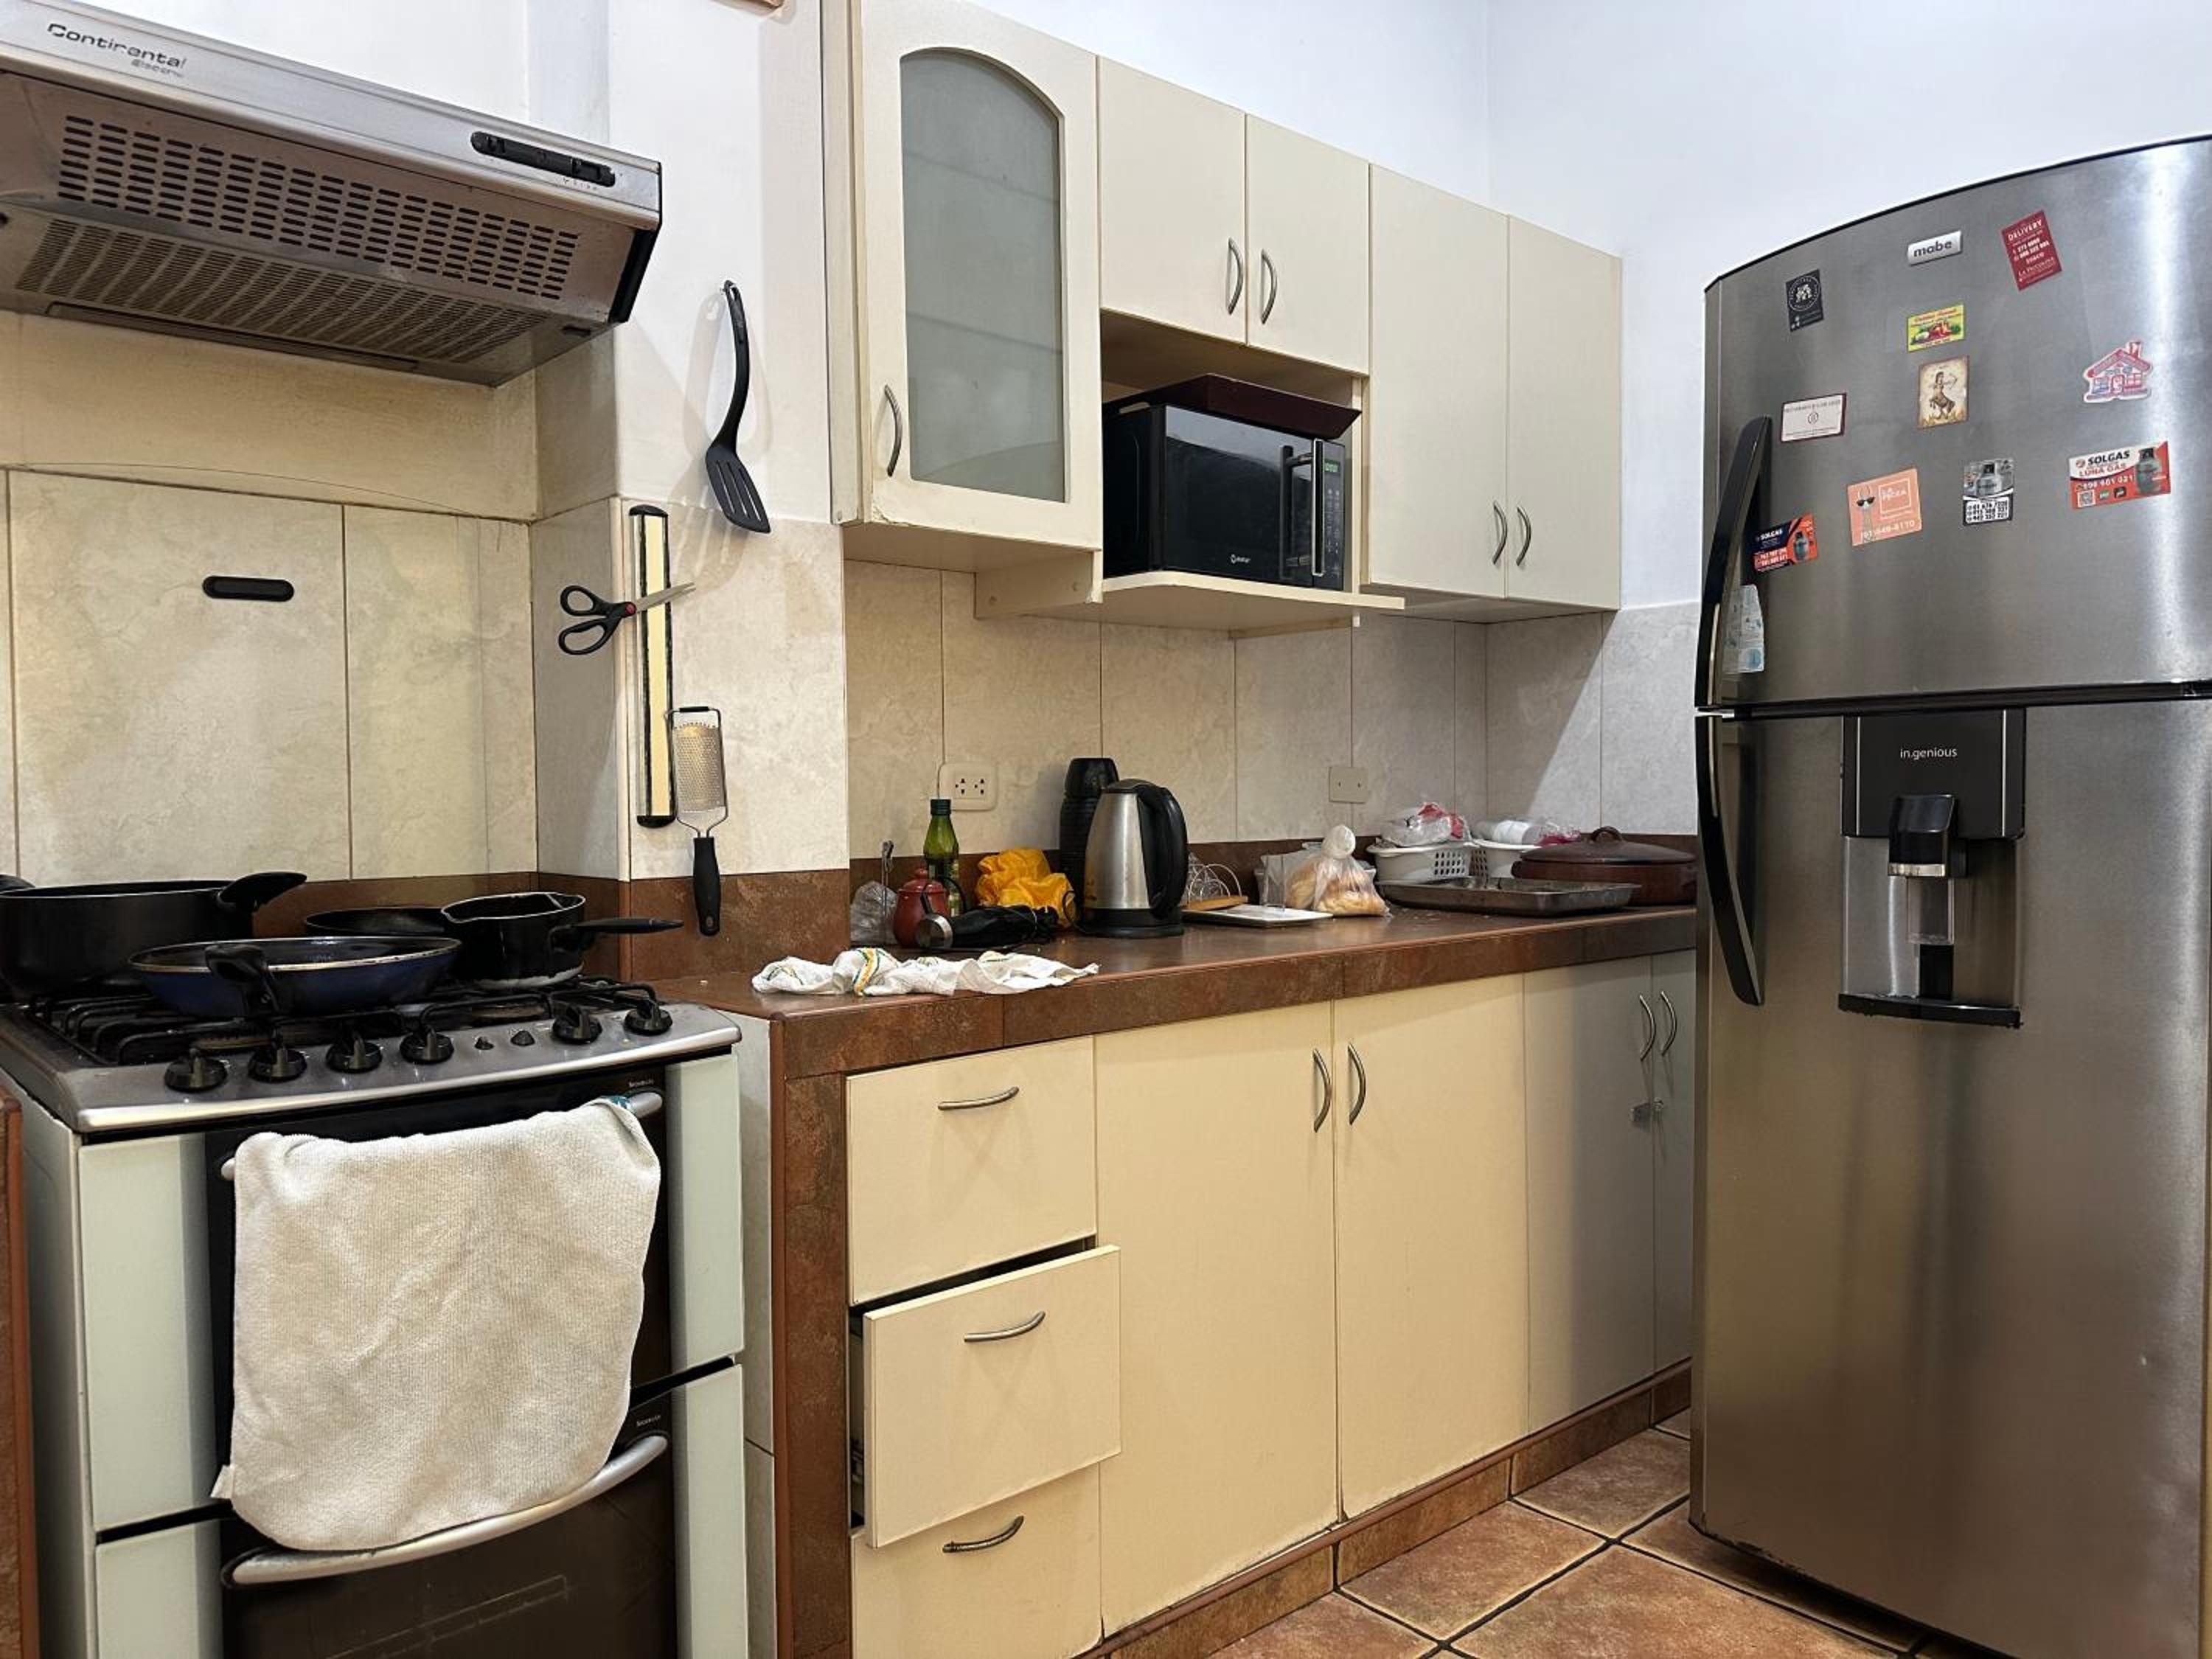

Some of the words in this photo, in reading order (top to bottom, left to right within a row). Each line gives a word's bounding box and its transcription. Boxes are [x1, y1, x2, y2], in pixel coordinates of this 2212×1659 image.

[46, 23, 187, 69] Continental
[2008, 219, 2042, 241] DELIVERY
[1913, 240, 1952, 257] mabe
[2087, 450, 2130, 465] SOLGAS
